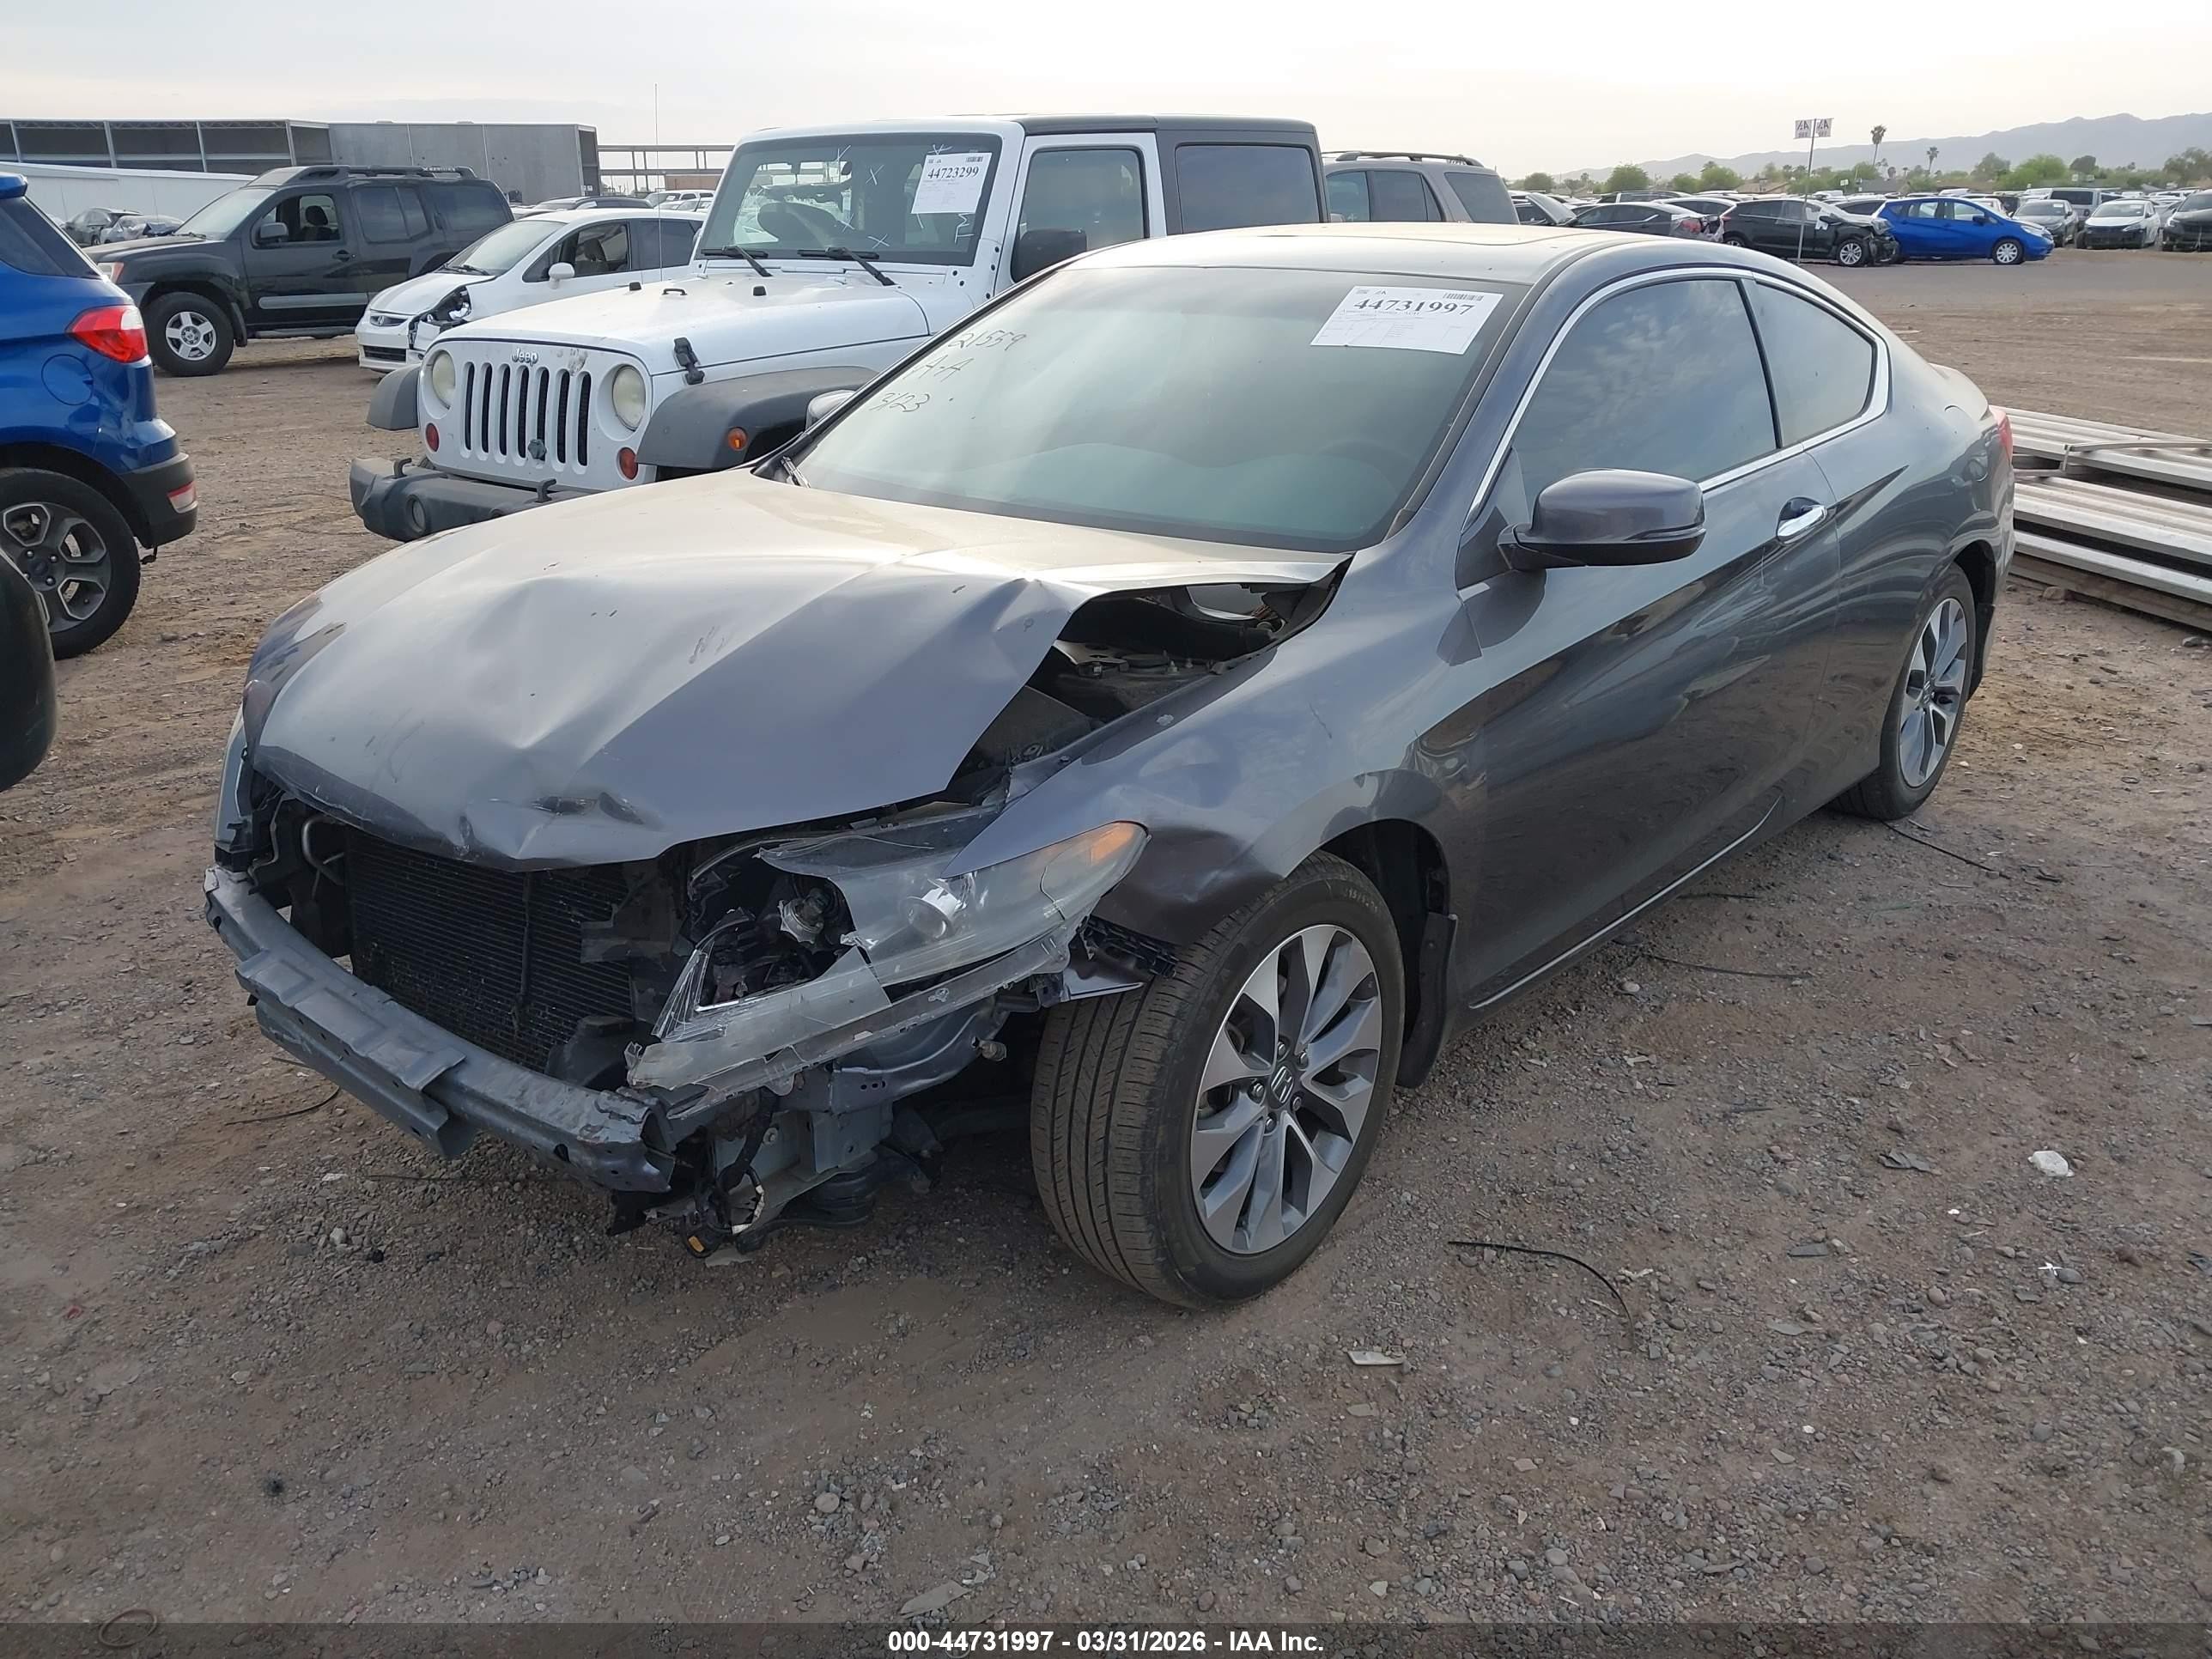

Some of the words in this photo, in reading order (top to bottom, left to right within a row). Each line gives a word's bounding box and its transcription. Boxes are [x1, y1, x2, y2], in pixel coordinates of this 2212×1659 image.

[927, 166, 980, 179] 44723299
[1353, 298, 1476, 316] 44731997
[512, 347, 539, 367] Jeep
